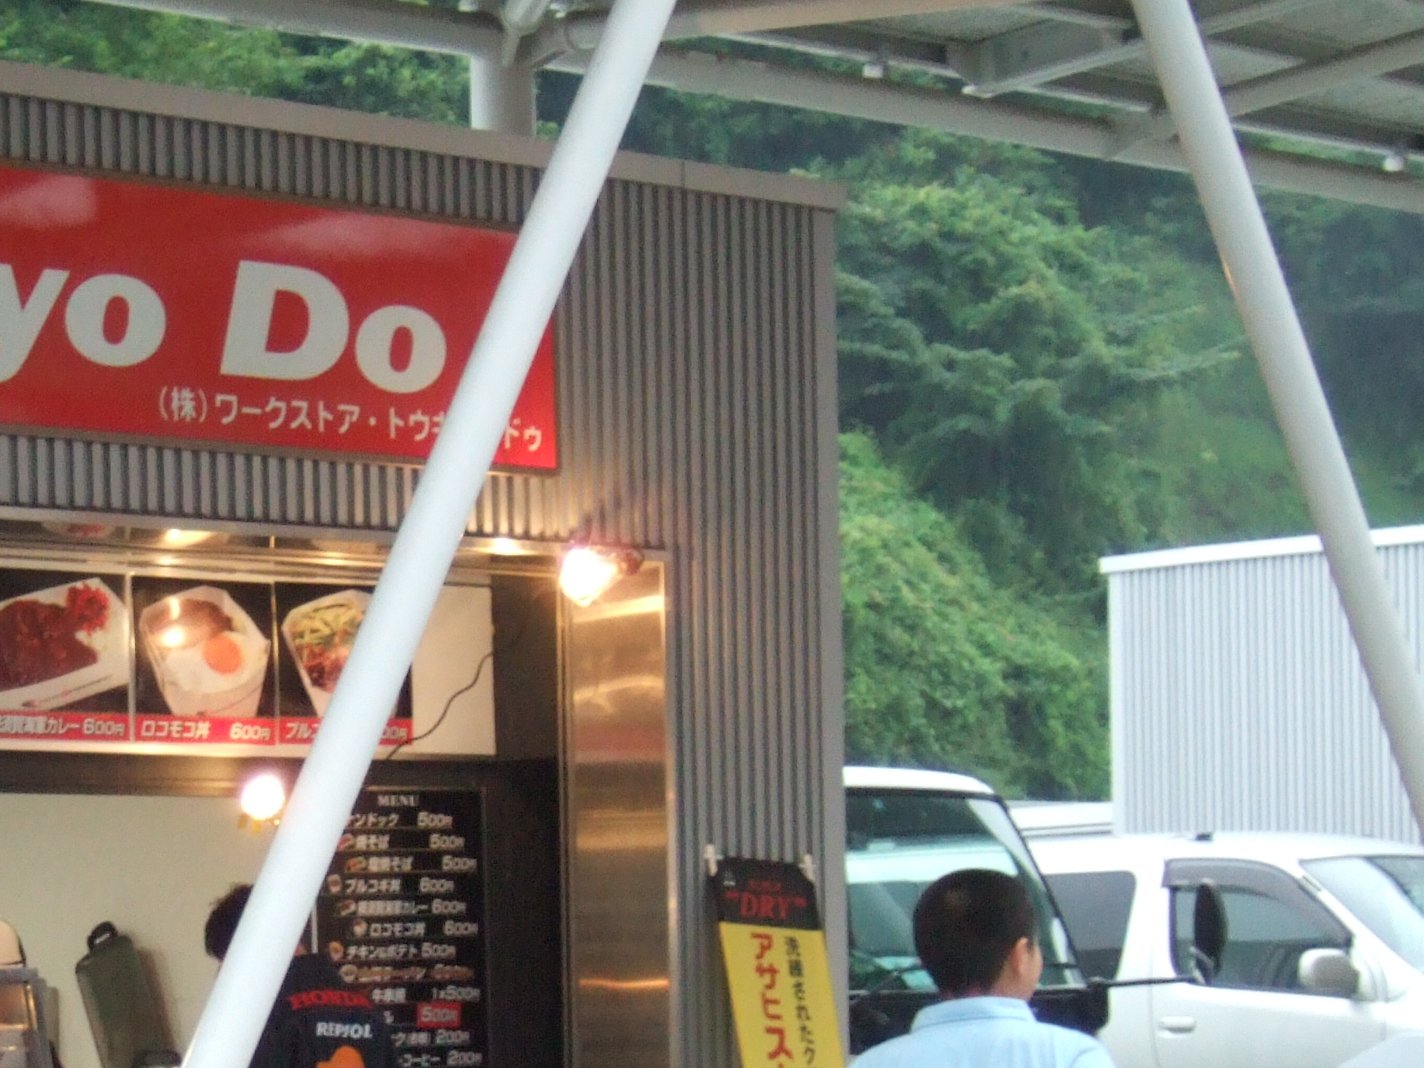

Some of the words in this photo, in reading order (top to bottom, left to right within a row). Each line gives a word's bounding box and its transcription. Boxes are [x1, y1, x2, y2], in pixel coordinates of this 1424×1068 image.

[220, 260, 446, 394] Do
[83, 718, 126, 737] 600円
[230, 722, 271, 742] 600円
[316, 1022, 373, 1039] REPSOL
